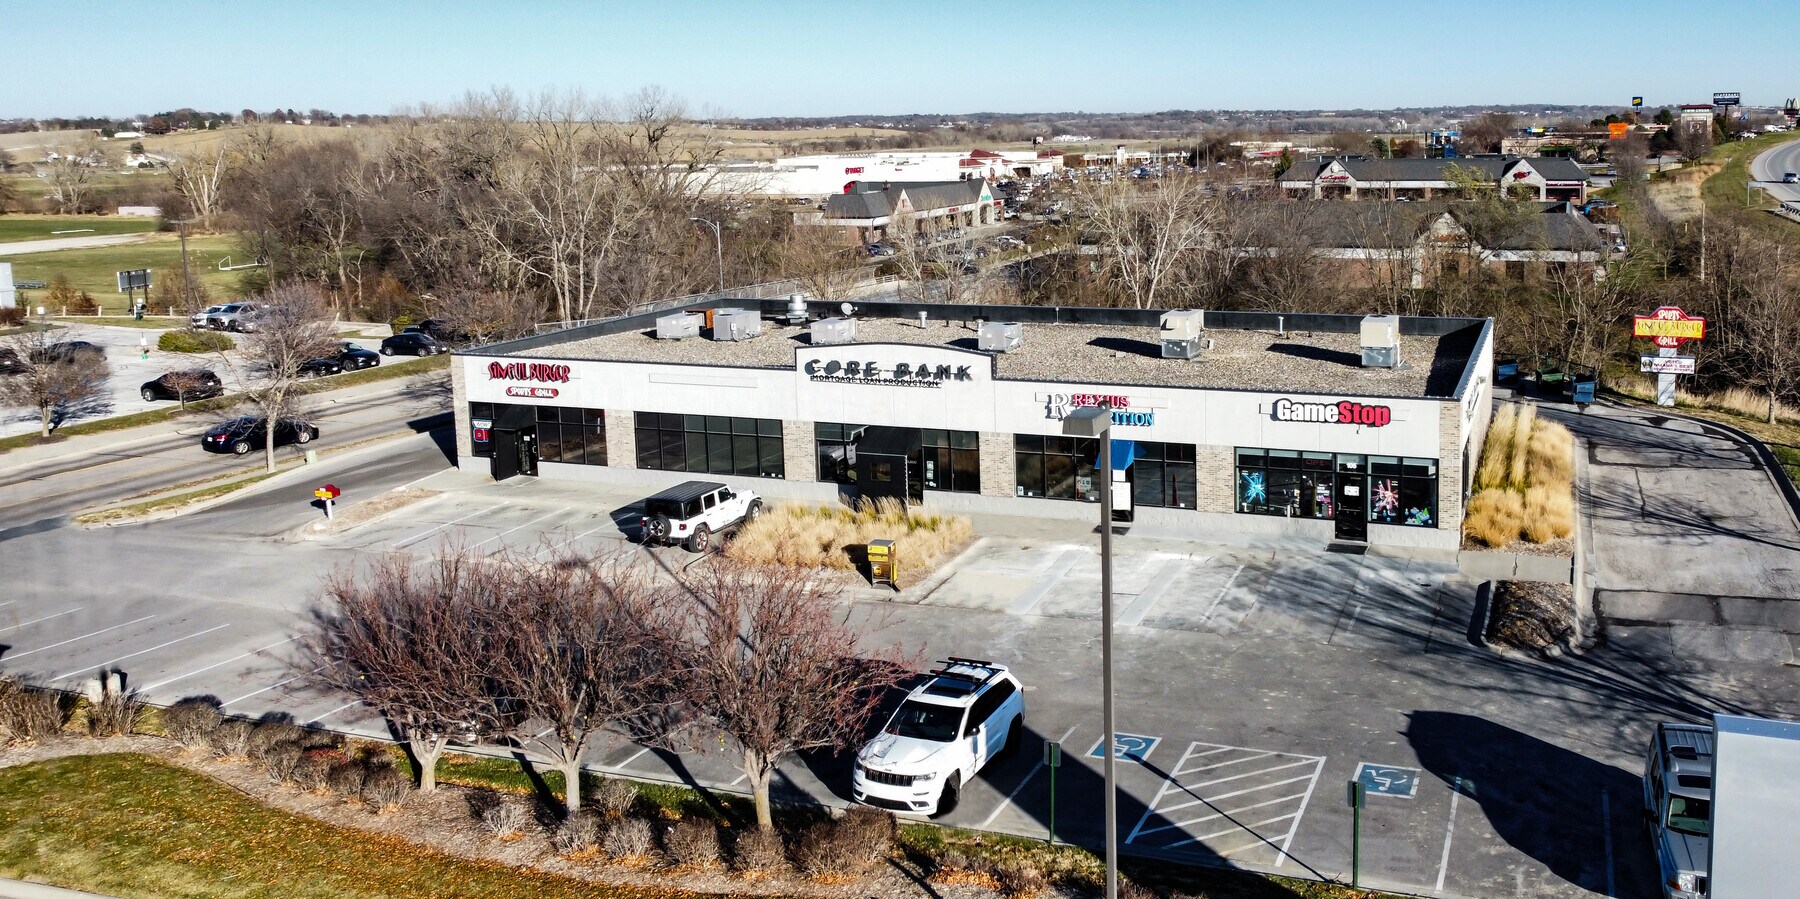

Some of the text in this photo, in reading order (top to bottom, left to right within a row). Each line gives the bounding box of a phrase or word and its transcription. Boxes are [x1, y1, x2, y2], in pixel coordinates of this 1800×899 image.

[1657, 309, 1681, 320] SPORTS
[1658, 336, 1678, 346] GRILL
[488, 360, 570, 383] SINFUL BURGER
[804, 358, 973, 382] CORE BANK
[811, 374, 940, 388] MORTGAGE LOAN PRODUCTION
[509, 387, 554, 398] SPORTS GRILL
[1110, 411, 1155, 427] RITION
[1273, 398, 1391, 428] GameStop
